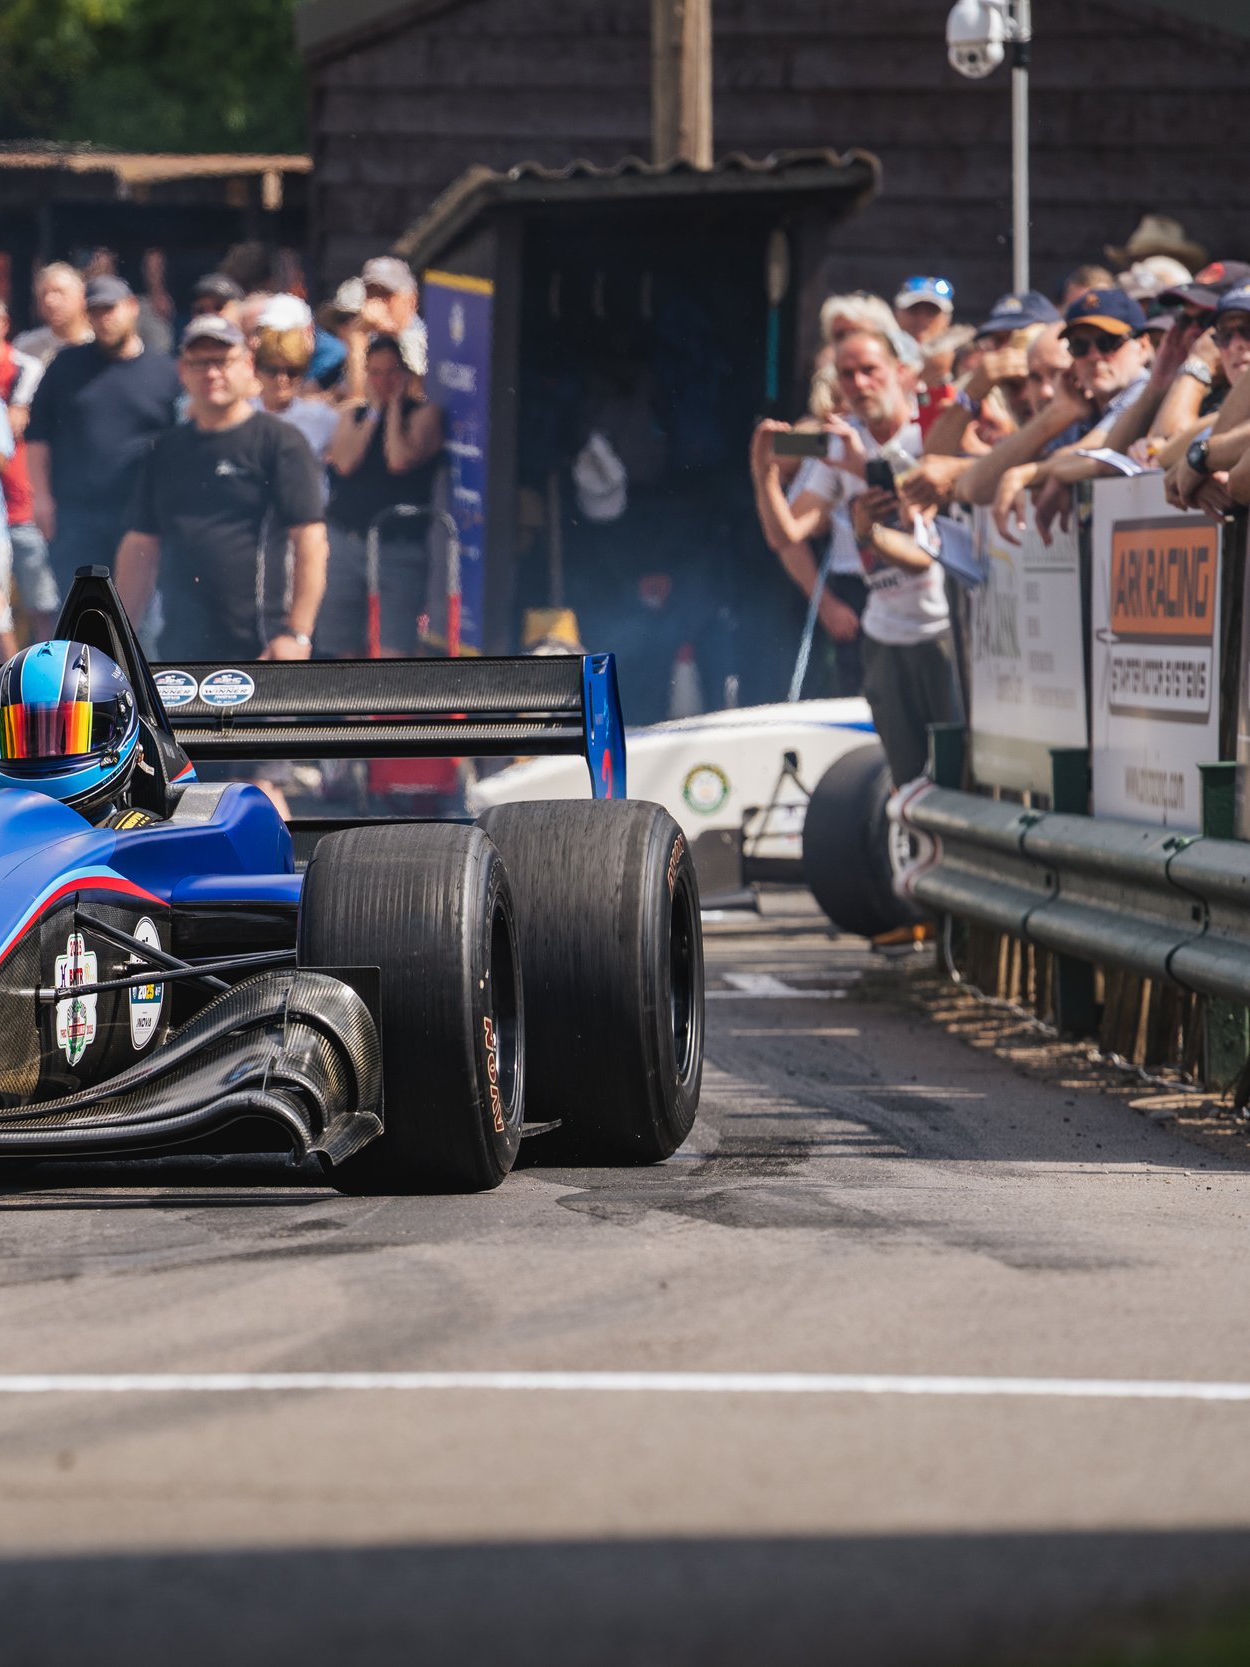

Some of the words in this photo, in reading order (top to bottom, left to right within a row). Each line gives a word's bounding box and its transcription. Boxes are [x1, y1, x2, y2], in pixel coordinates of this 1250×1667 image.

[1113, 548, 1146, 617] ARK
[1147, 546, 1209, 618] RACING
[138, 984, 155, 1000] 2025
